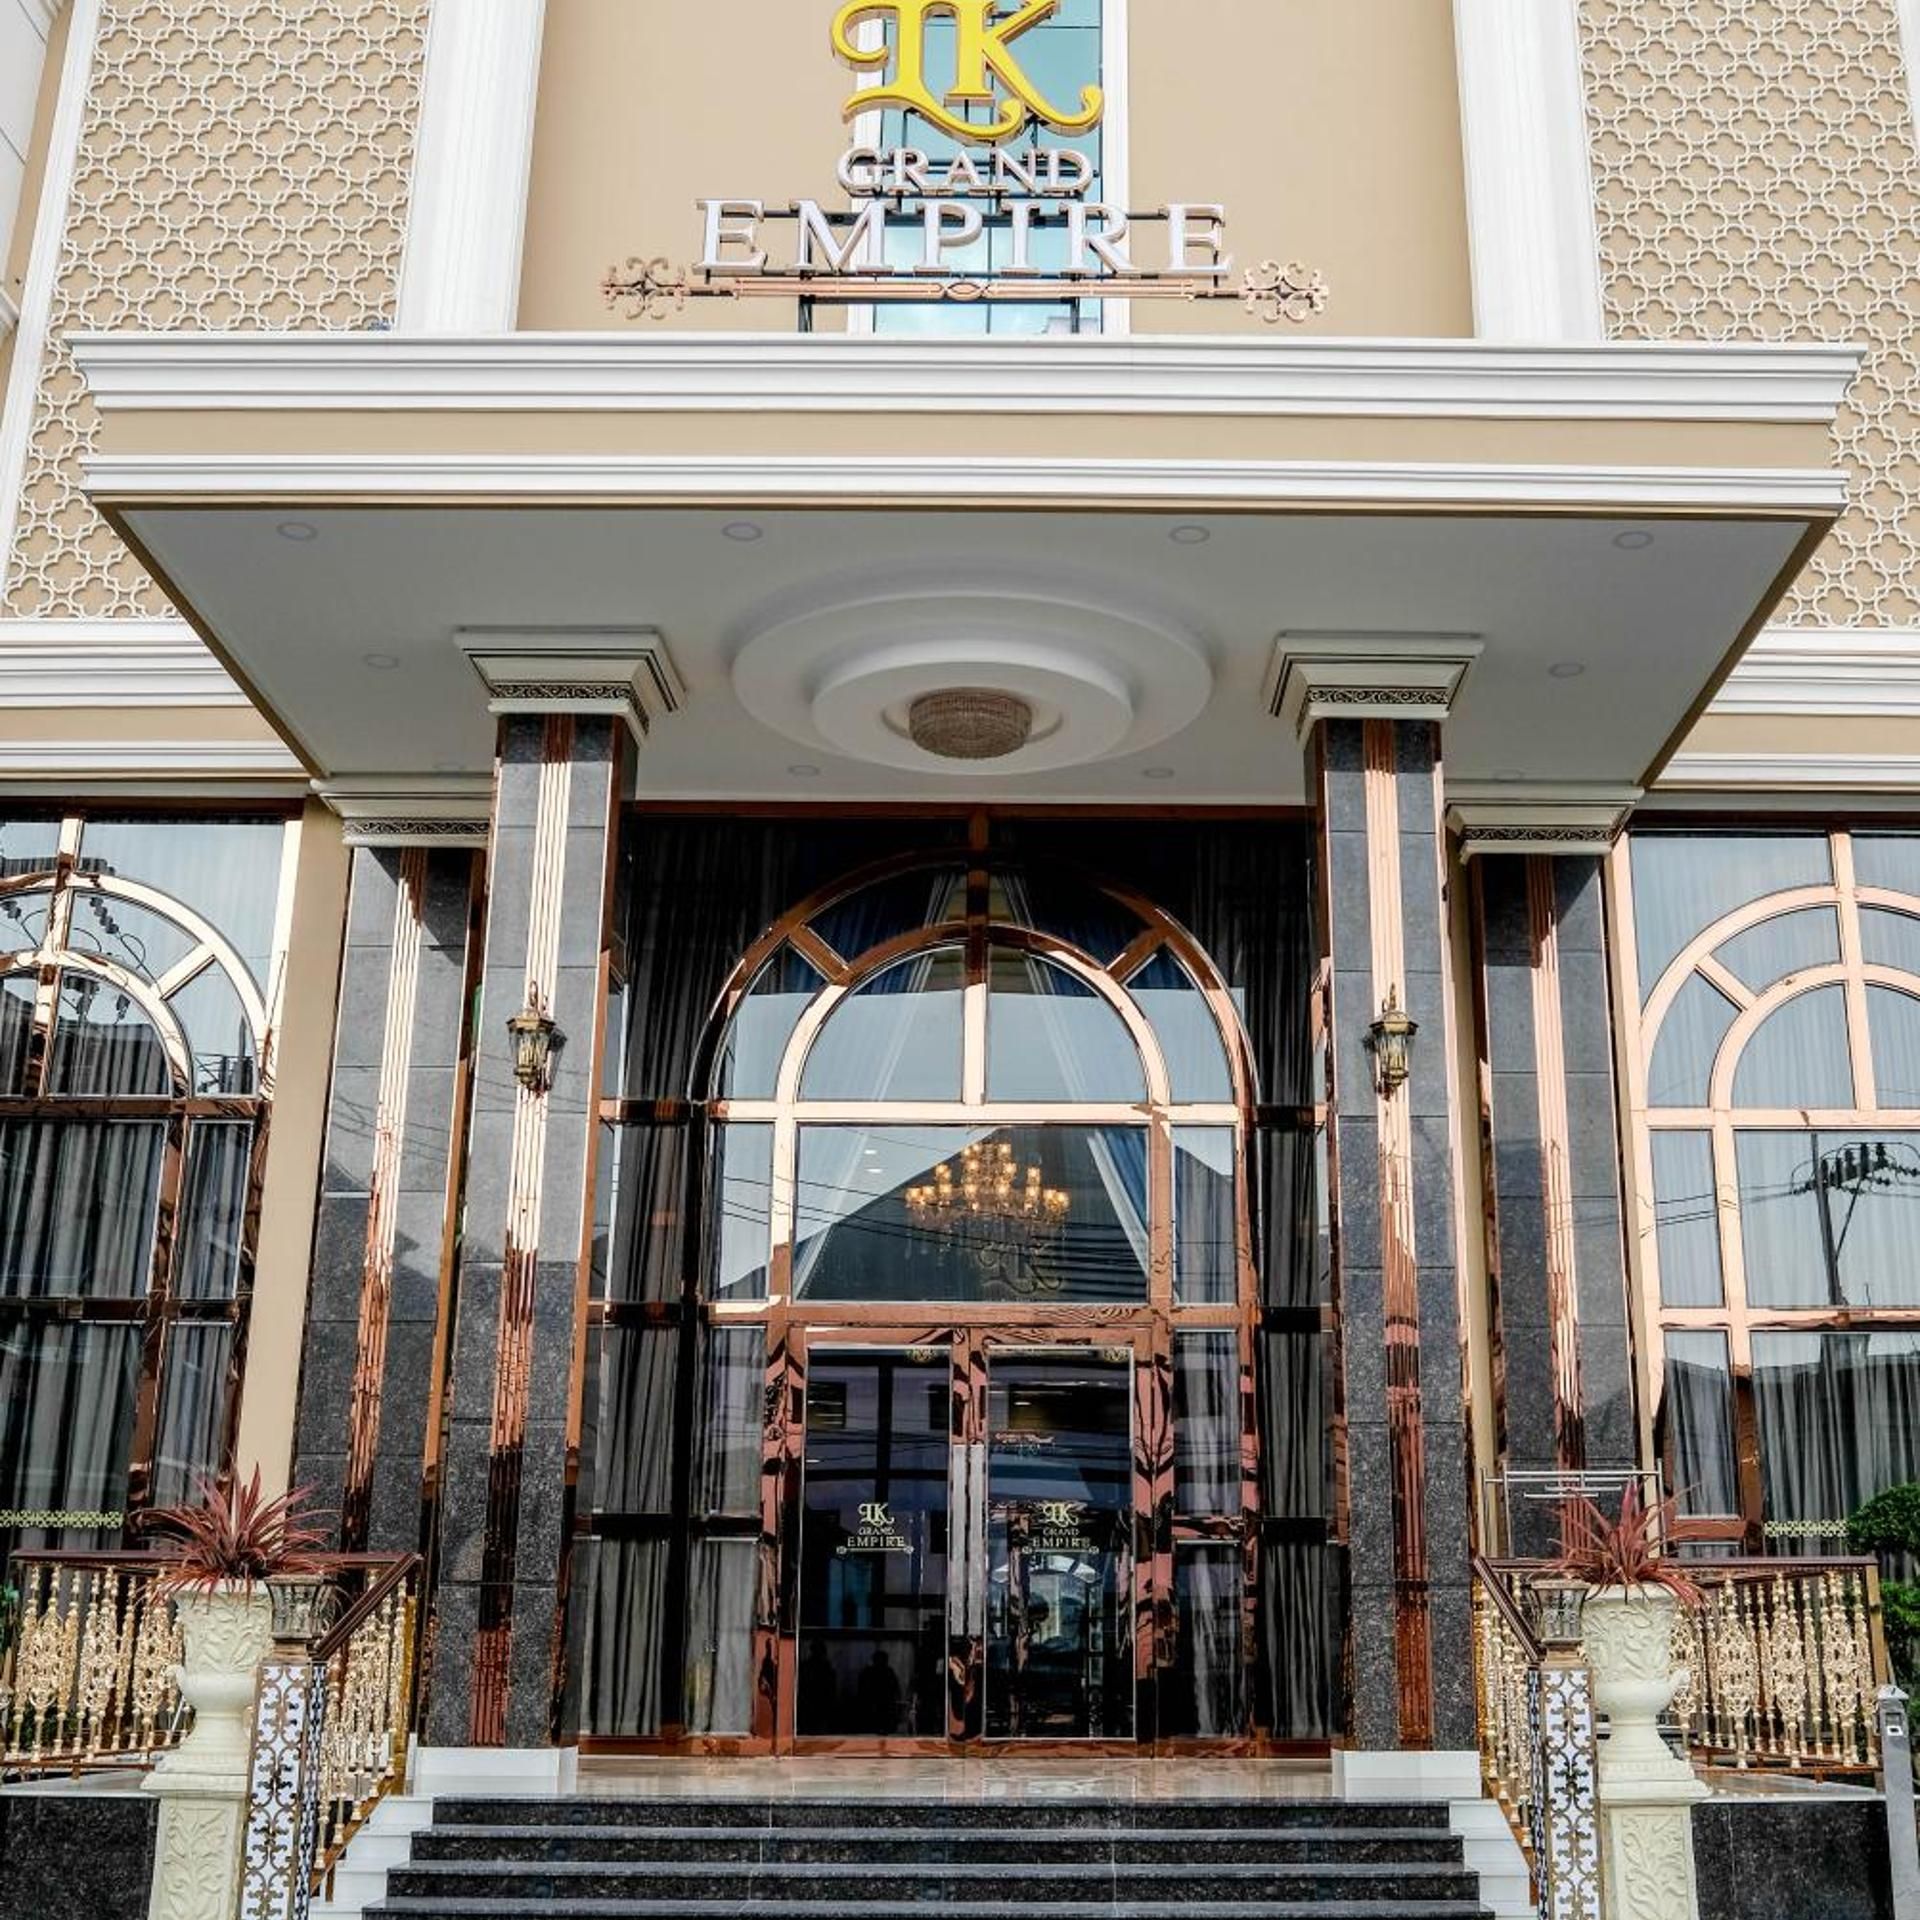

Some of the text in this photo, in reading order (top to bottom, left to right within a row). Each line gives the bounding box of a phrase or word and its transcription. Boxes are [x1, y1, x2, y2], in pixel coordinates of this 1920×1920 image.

[838, 146, 1094, 198] GRAND
[693, 198, 1233, 276] EMPIRE
[847, 1536, 905, 1547] EMPIRE
[1033, 1536, 1091, 1547] EMPIRE
